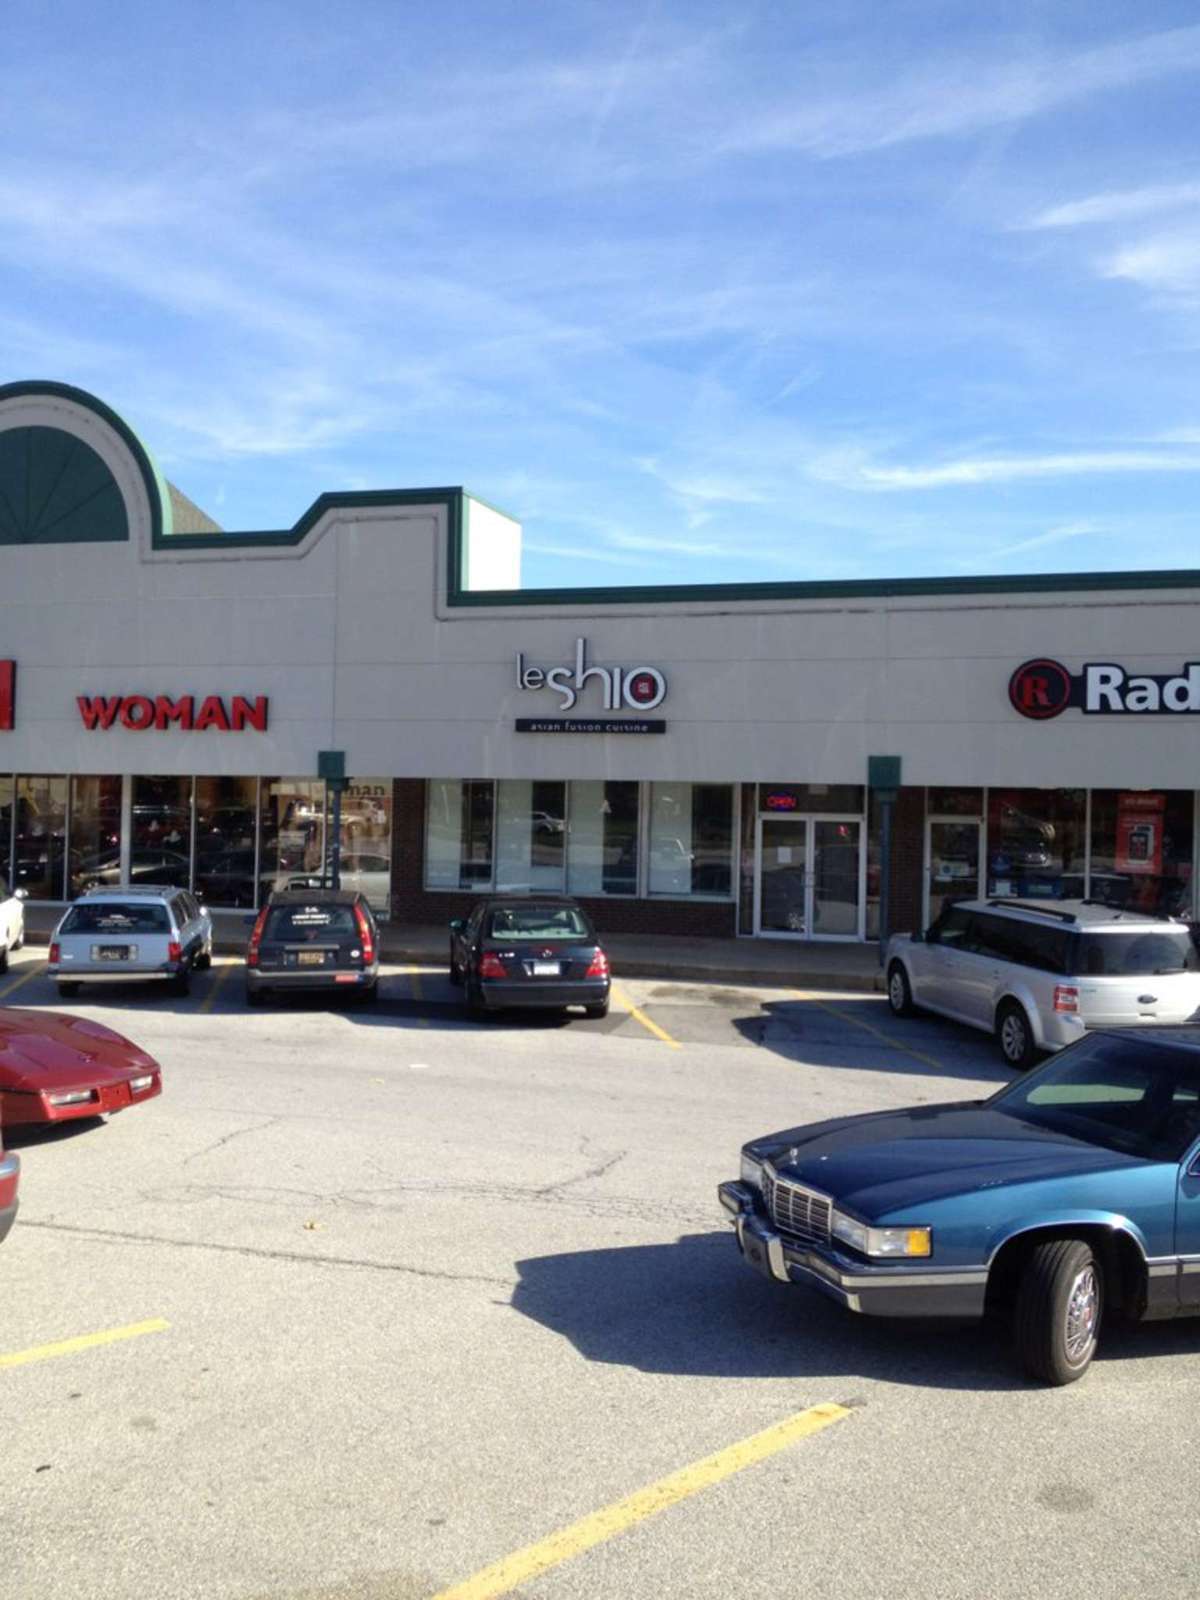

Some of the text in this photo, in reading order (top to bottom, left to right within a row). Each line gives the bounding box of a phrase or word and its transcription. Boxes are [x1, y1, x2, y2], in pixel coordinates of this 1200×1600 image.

[1086, 664, 1200, 712] Rad
[76, 695, 268, 732] WOMAN
[530, 721, 649, 733] asian fusion cuisine
